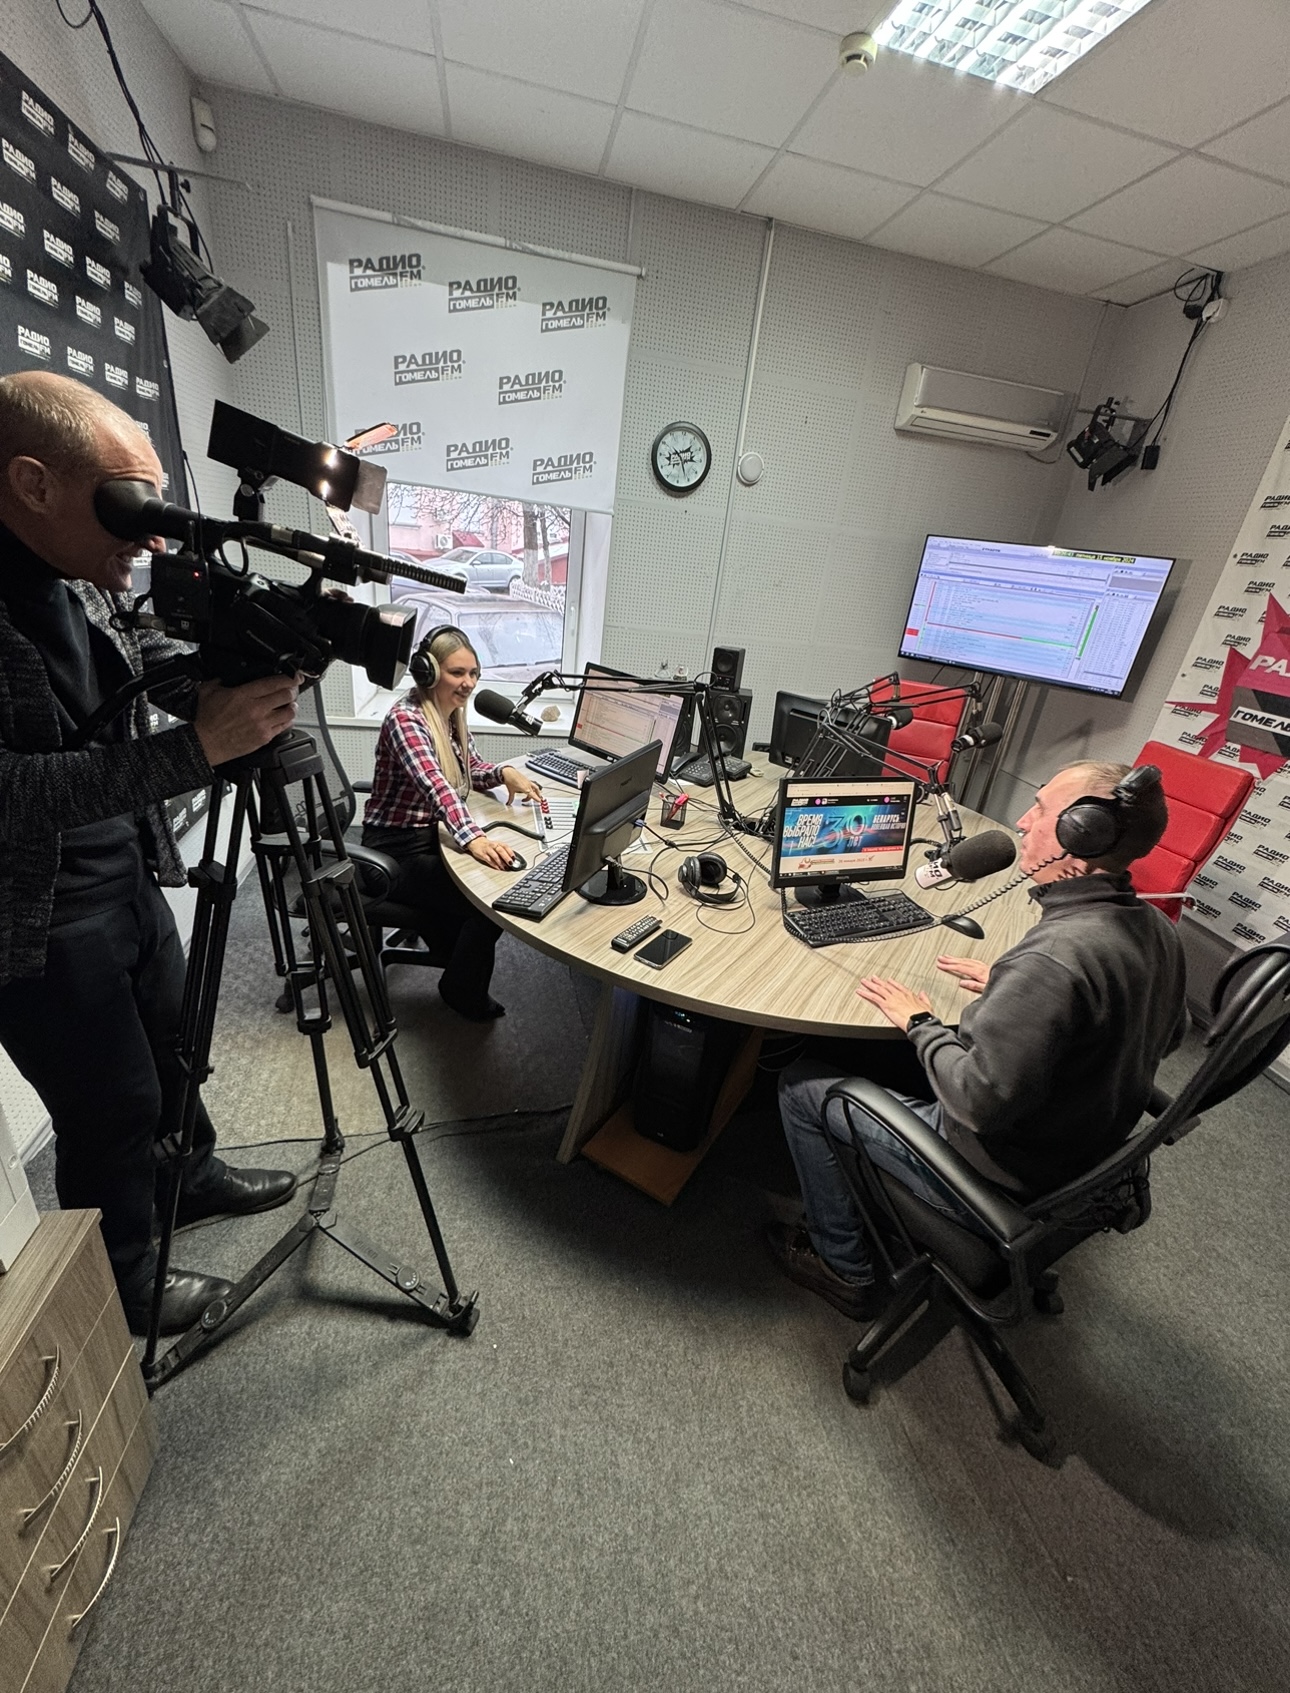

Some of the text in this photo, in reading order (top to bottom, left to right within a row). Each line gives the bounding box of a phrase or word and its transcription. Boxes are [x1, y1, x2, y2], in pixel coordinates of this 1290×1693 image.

[1, 137, 35, 172] РАДИО
[0, 201, 24, 224] ДИО
[43, 228, 73, 256] РАДИО
[349, 253, 422, 274] РАДИО
[26, 268, 58, 294] РАДИО
[351, 269, 422, 289] ГОМЕЛЬ FM
[448, 275, 517, 297] РАДИО
[450, 291, 517, 310] ГОМЕЛЬ FM
[541, 296, 608, 317] РАДИО
[542, 311, 607, 330] ГОМЕЛЬ FM
[18, 325, 50, 348] РАДИО
[67, 346, 94, 365] РАДИО
[394, 349, 462, 370] РАДИО
[395, 364, 462, 383] ГОМЕЛЬ FM
[499, 369, 564, 390] РАДИО
[500, 383, 563, 403] ГОМЕЛЬ FM
[401, 435, 422, 447] FM
[446, 437, 510, 458] РАДИО
[448, 451, 510, 470] ГОМЕЛЬ FM
[532, 451, 594, 472] РАДИО
[533, 464, 593, 483] ГОМЕЛЬ FM
[1249, 655, 1290, 678] РА
[797, 814, 824, 826] ВРЕМЯ
[783, 825, 820, 838] ВЫБРАЛО
[798, 836, 817, 848] НАС!
[1257, 844, 1290, 861] РАДИО
[1197, 874, 1218, 887] АДИО
[1232, 891, 1262, 909] РАДИО
[1236, 922, 1266, 941] РАДИО
